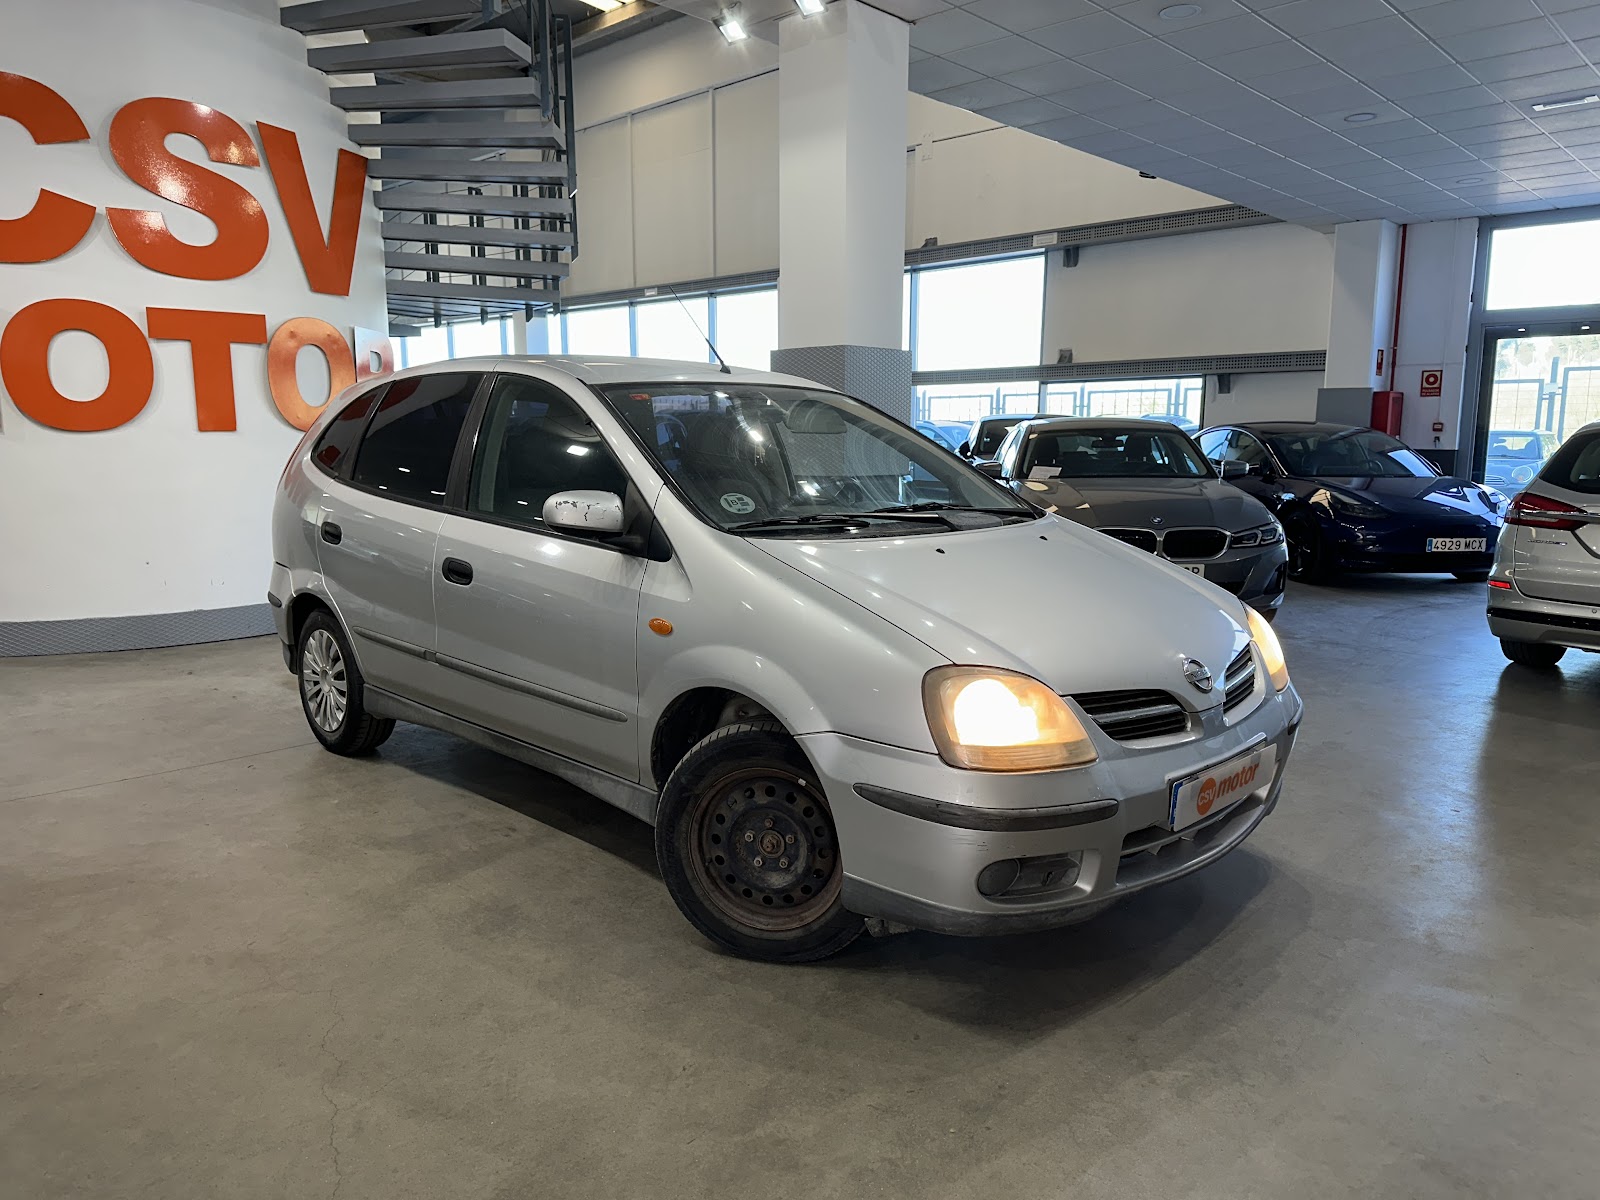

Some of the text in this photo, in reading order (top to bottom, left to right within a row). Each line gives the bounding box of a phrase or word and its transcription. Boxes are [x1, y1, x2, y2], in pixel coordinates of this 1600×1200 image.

[1433, 539, 1484, 550] 4929 MCX
[1216, 762, 1259, 799] motor
